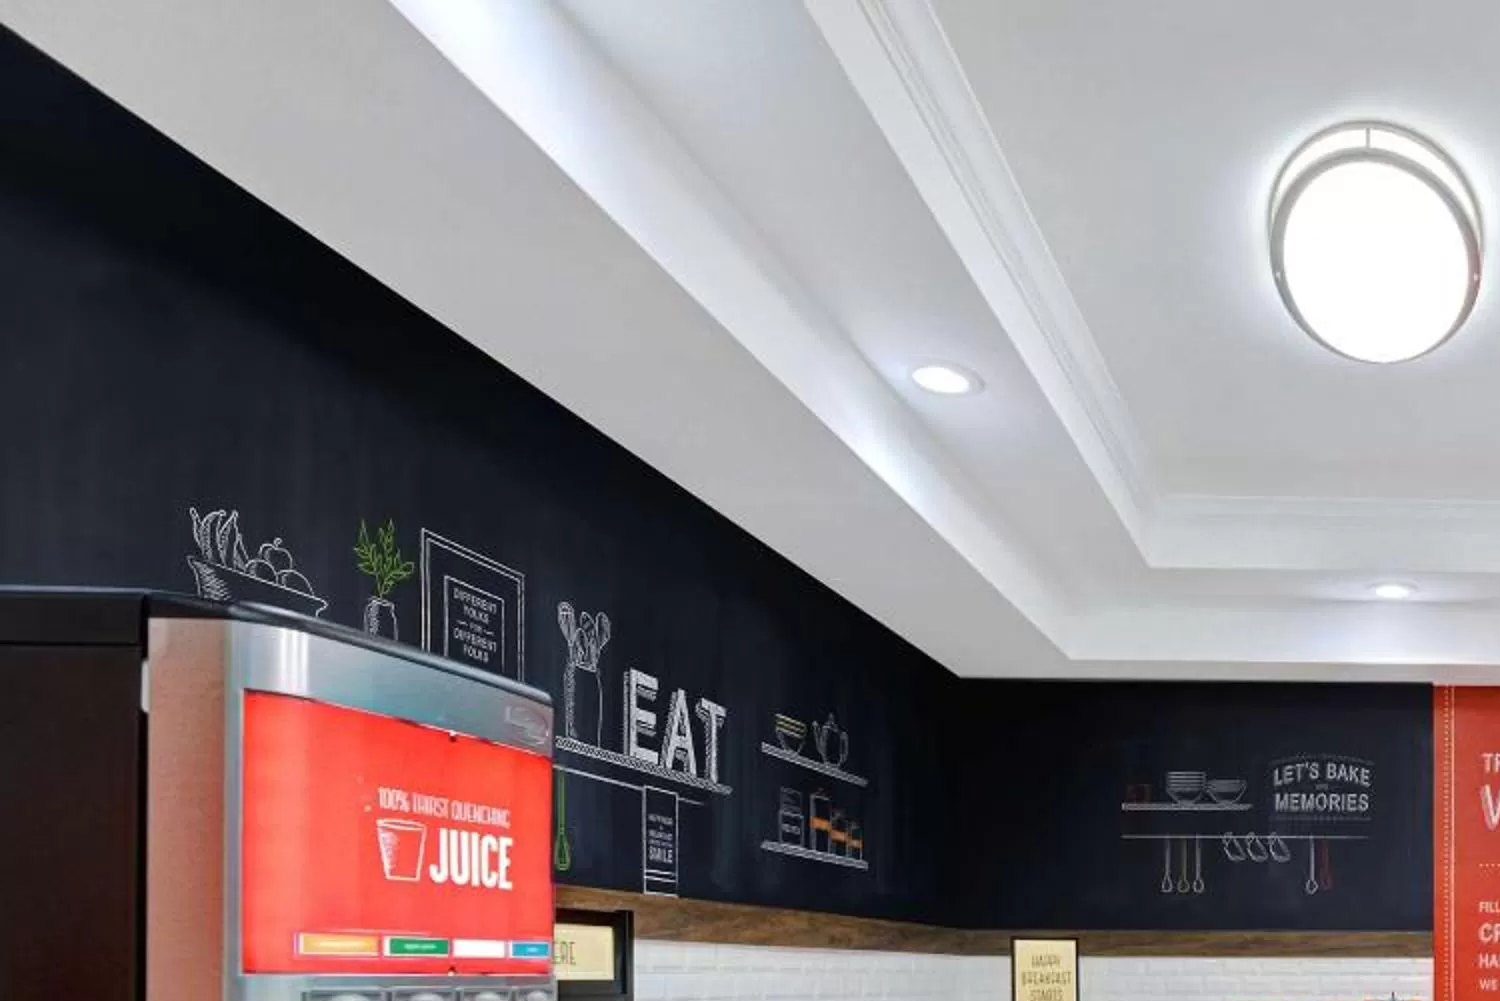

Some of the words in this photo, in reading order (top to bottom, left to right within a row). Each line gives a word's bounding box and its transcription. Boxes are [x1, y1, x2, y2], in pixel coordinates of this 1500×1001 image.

[453, 588, 497, 614] DIFFERENT
[453, 628, 497, 652] DIFFERENT
[623, 667, 727, 783] EAT
[1273, 761, 1319, 786] LET'S
[1327, 761, 1371, 787] BAKE
[378, 786, 409, 812] 100%
[1275, 792, 1369, 812] MEMORIES
[428, 826, 513, 891] JUICE
[1479, 901, 1500, 913] FILL
[1480, 979, 1498, 991] WE
